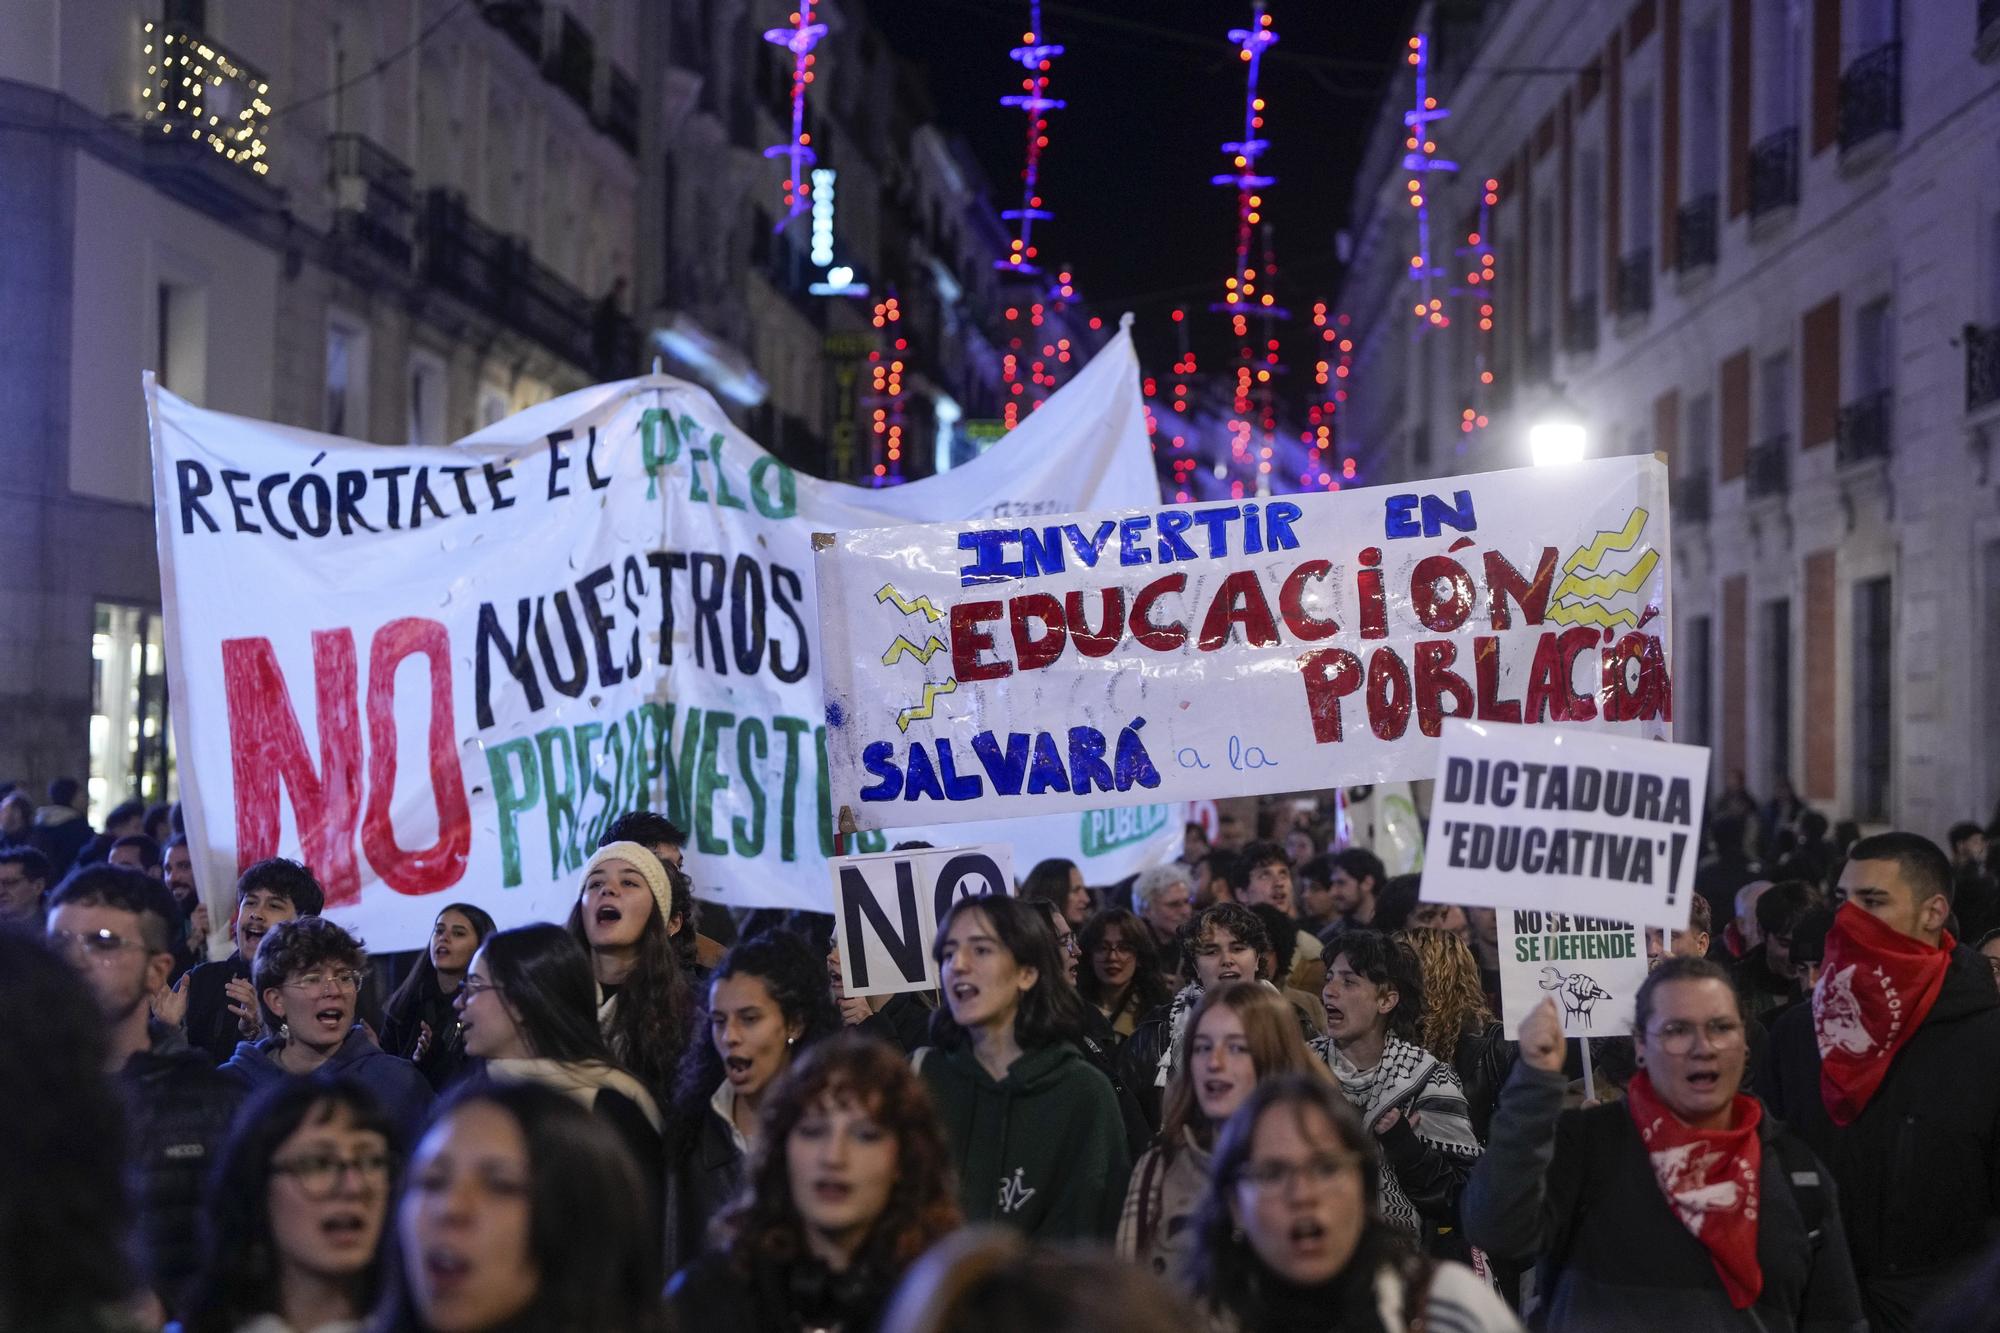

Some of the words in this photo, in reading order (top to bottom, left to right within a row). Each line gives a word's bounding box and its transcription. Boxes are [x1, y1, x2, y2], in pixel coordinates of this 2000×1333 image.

[176, 450, 516, 540] RECÓRTATE
[547, 425, 612, 502] EL
[640, 407, 797, 520] PELO
[1384, 489, 1478, 540] EN
[475, 551, 810, 730] NUESTROS
[221, 616, 472, 912] NO
[860, 716, 1161, 801] SALVARÁ
[1177, 747, 1211, 769] a
[1228, 734, 1278, 771] la
[1443, 755, 1692, 827] DICTADURA
[1513, 910, 1542, 935] NO
[1546, 911, 1570, 933] SE
[1515, 937, 1540, 962] SE
[1544, 933, 1636, 961] DEFIENDE
